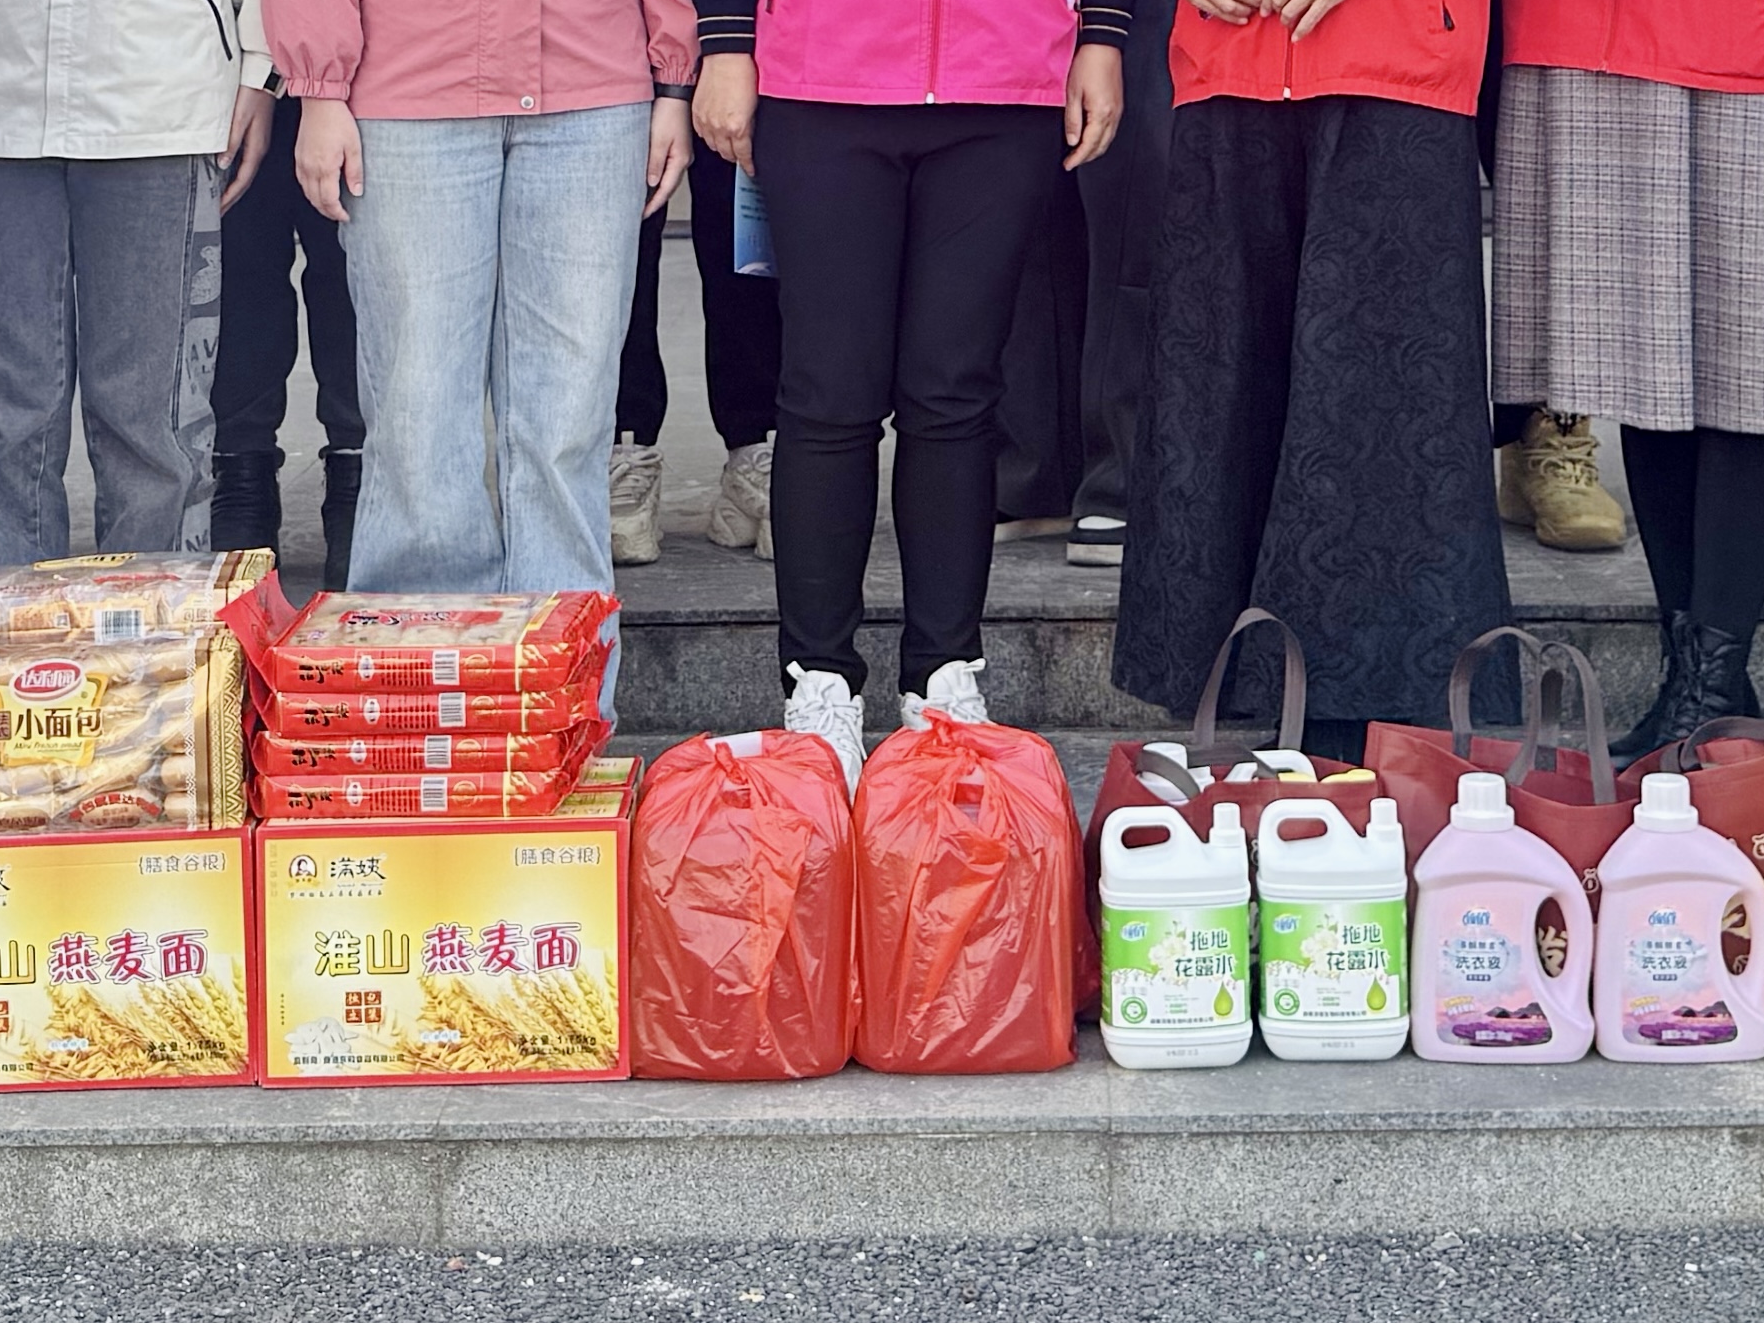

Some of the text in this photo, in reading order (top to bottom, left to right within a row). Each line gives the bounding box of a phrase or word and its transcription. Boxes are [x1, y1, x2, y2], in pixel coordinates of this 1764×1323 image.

[14, 707, 103, 740] 小面包
[1189, 928, 1230, 951] 拖地
[1341, 922, 1382, 945] 拖地
[48, 928, 208, 987] 燕麦面
[314, 919, 582, 977] 淮山 燕麦面
[1326, 948, 1387, 971] 花露水
[1174, 954, 1234, 978] 花露水
[1454, 954, 1502, 970] 洗衣液
[1640, 954, 1688, 970] 洗衣液
